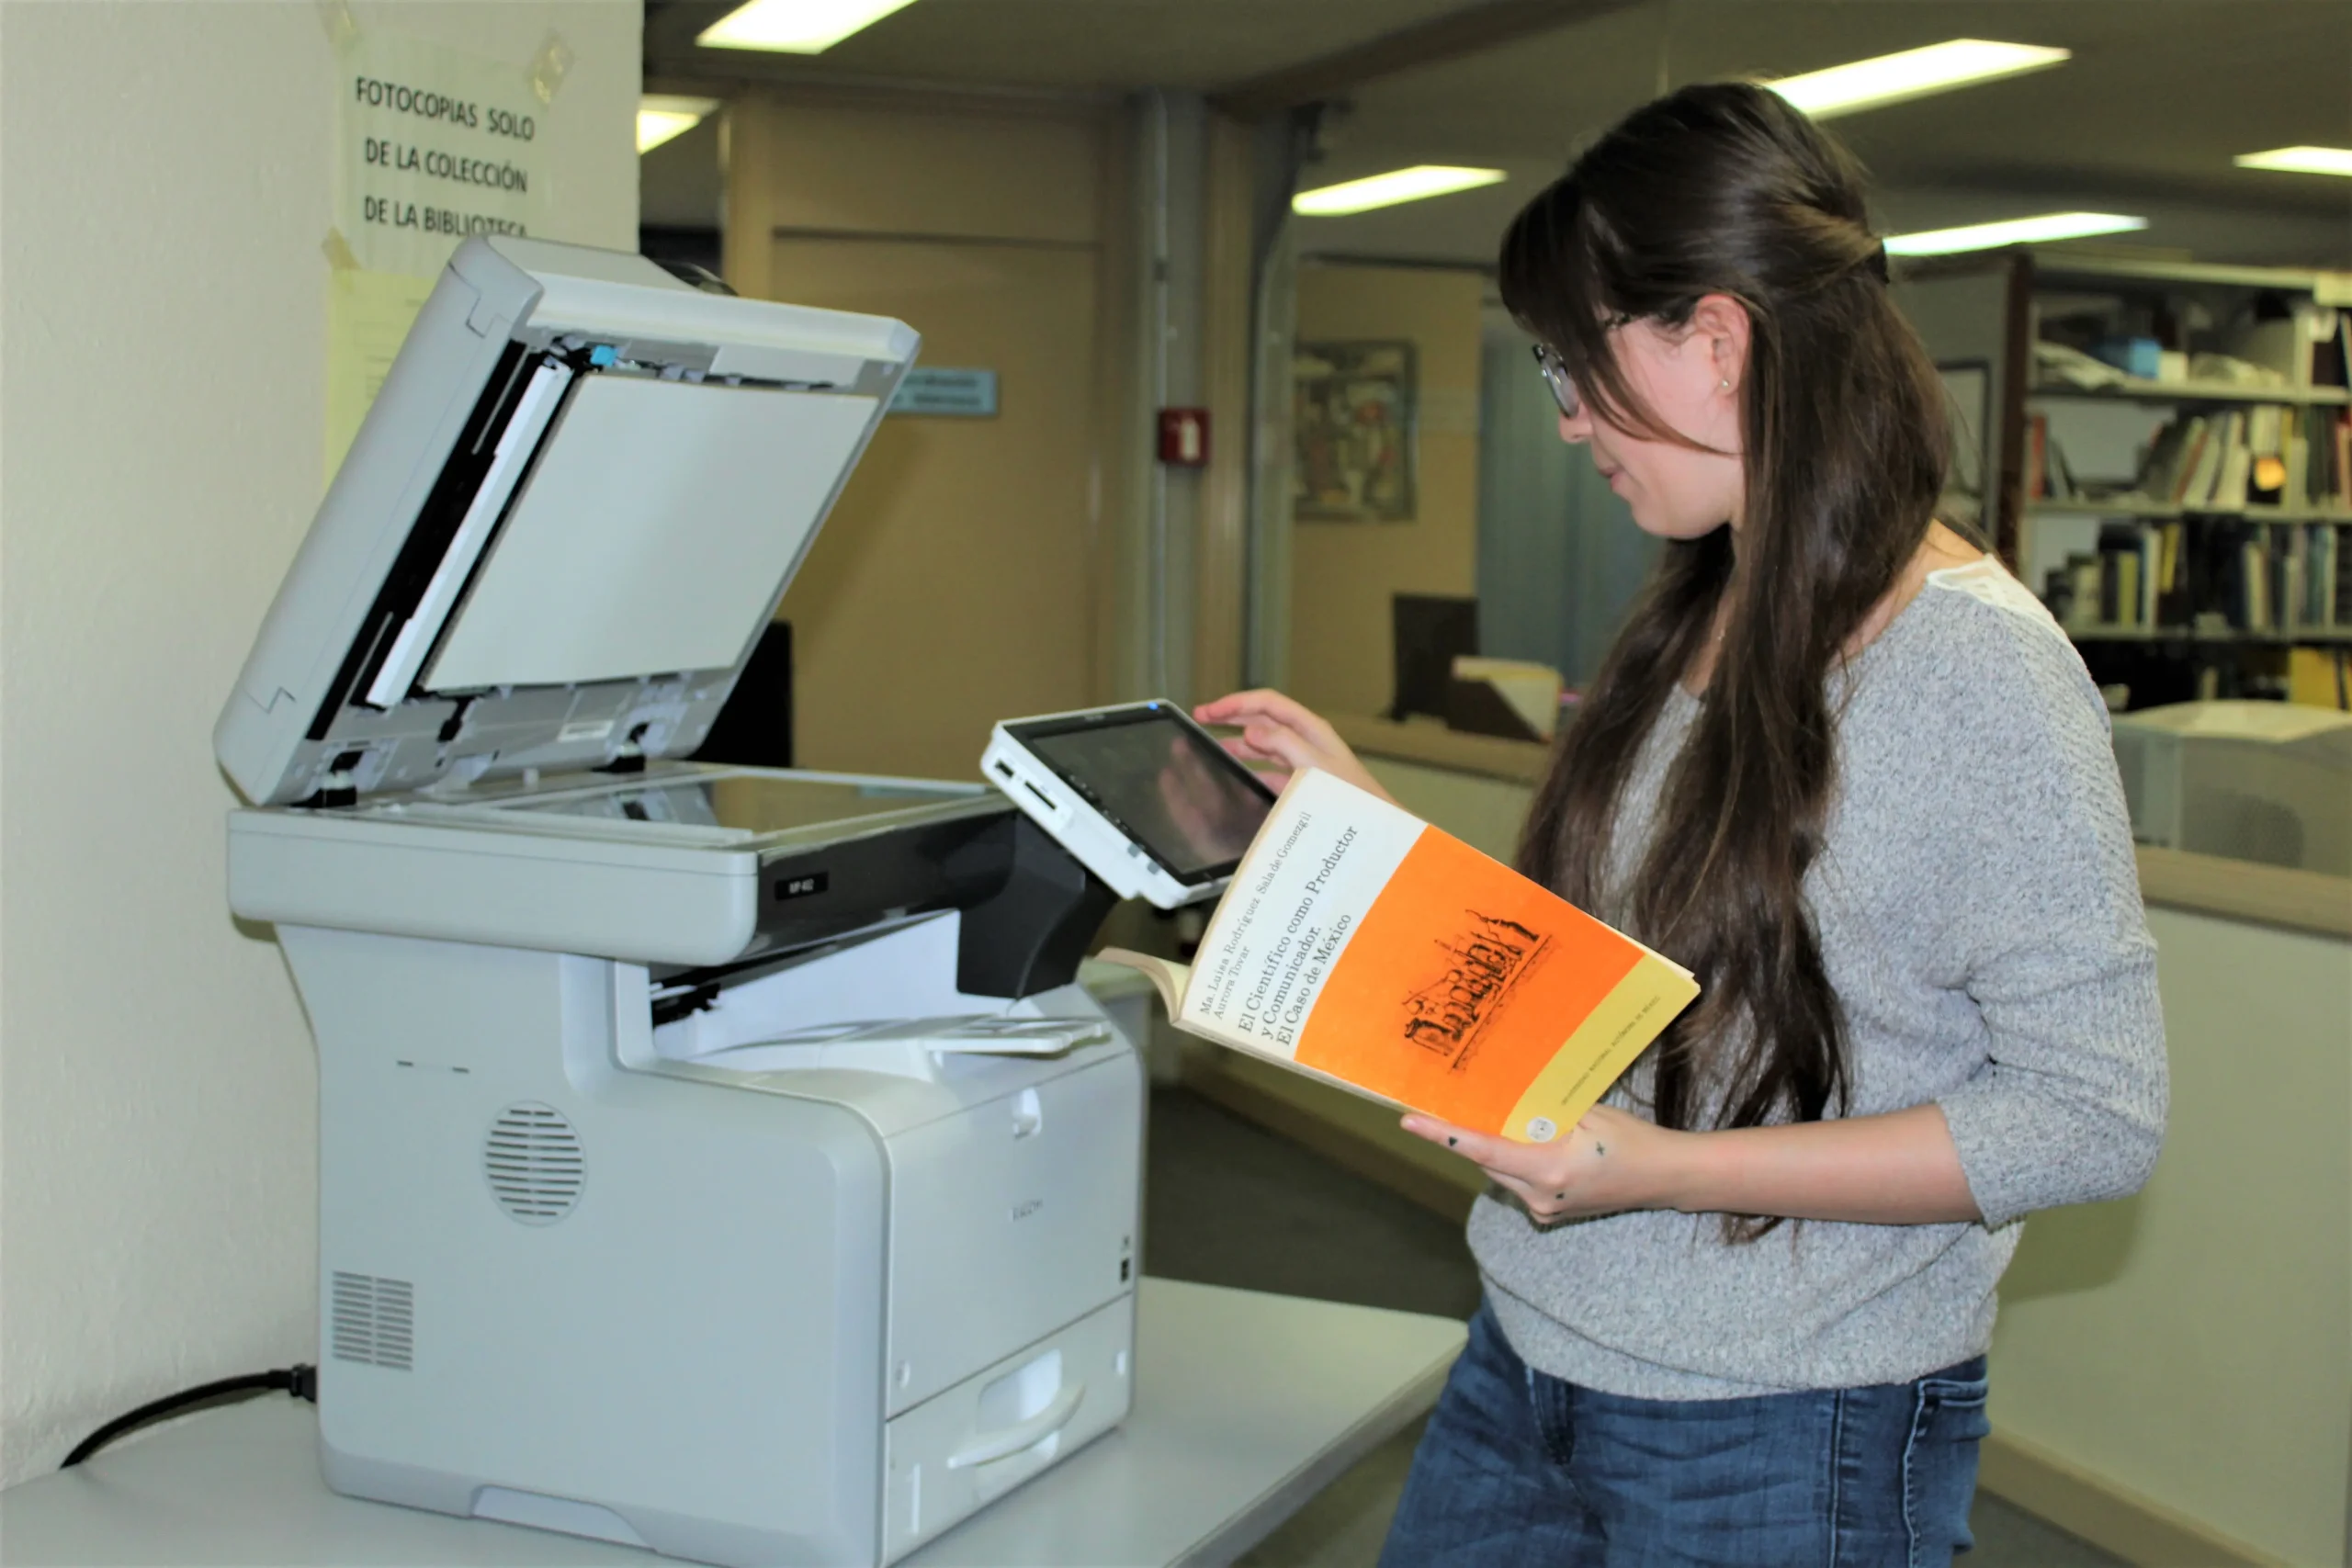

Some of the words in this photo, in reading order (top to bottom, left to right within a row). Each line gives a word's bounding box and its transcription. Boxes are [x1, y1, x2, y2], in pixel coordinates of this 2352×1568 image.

[356, 76, 478, 128] FOTOCOPIAS
[488, 107, 535, 141] SOLO
[365, 137, 390, 166] DE
[397, 144, 420, 173] LA
[425, 150, 528, 193] COLECCIÓN
[364, 196, 388, 224] DE
[395, 201, 418, 228] LA
[1305, 826, 1358, 895] Productor
[1256, 872, 1275, 895] Sala
[1223, 897, 1261, 953] Rodríguez
[1287, 897, 1314, 934] como
[1313, 914, 1351, 964] México
[1207, 958, 1229, 992] Luisa
[1213, 979, 1236, 1021] Aurora
[1228, 946, 1250, 976] Tovar
[1246, 936, 1291, 1011] Científico
[1262, 926, 1321, 1025] Comunicador.
[1304, 966, 1321, 986] de
[1200, 993, 1216, 1015] Ma.
[1284, 987, 1310, 1024] Caso
[1238, 1013, 1256, 1033] El
[1261, 1027, 1273, 1040] y
[1277, 1026, 1295, 1046] El
